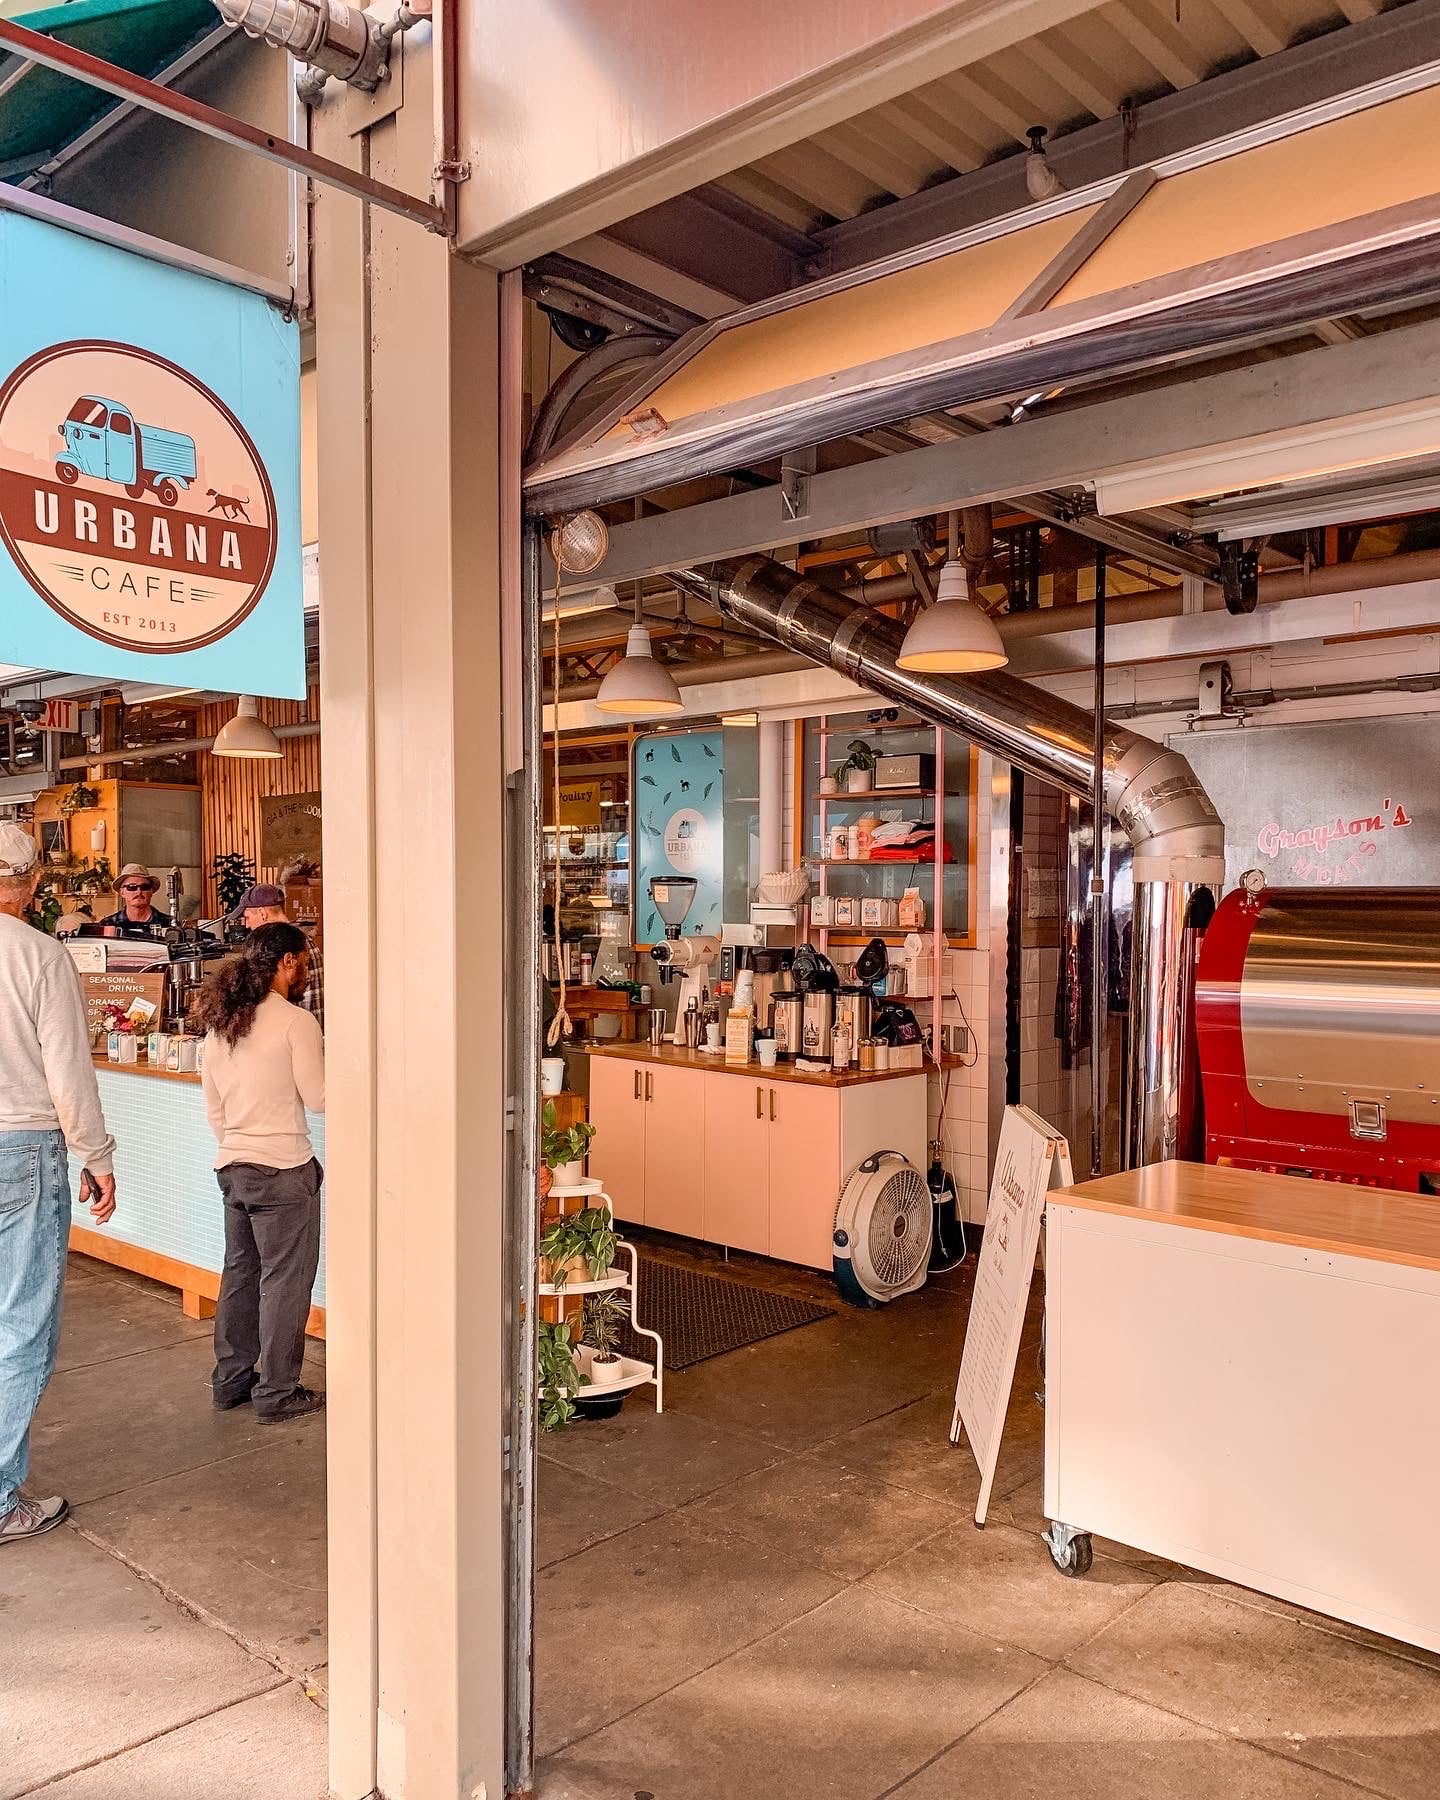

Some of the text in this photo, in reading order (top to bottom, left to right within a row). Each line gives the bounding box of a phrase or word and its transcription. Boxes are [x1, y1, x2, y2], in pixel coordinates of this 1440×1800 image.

[35, 490, 242, 570] URBANA
[90, 566, 185, 604] CAFE
[103, 611, 177, 633] EST 2013
[37, 700, 72, 729] XIT
[1257, 797, 1412, 859] Grayson's
[1291, 838, 1377, 885] MEATS
[88, 976, 137, 984] SEASONAL
[108, 985, 145, 993] DRINKS
[88, 998, 126, 1007] ORANGE
